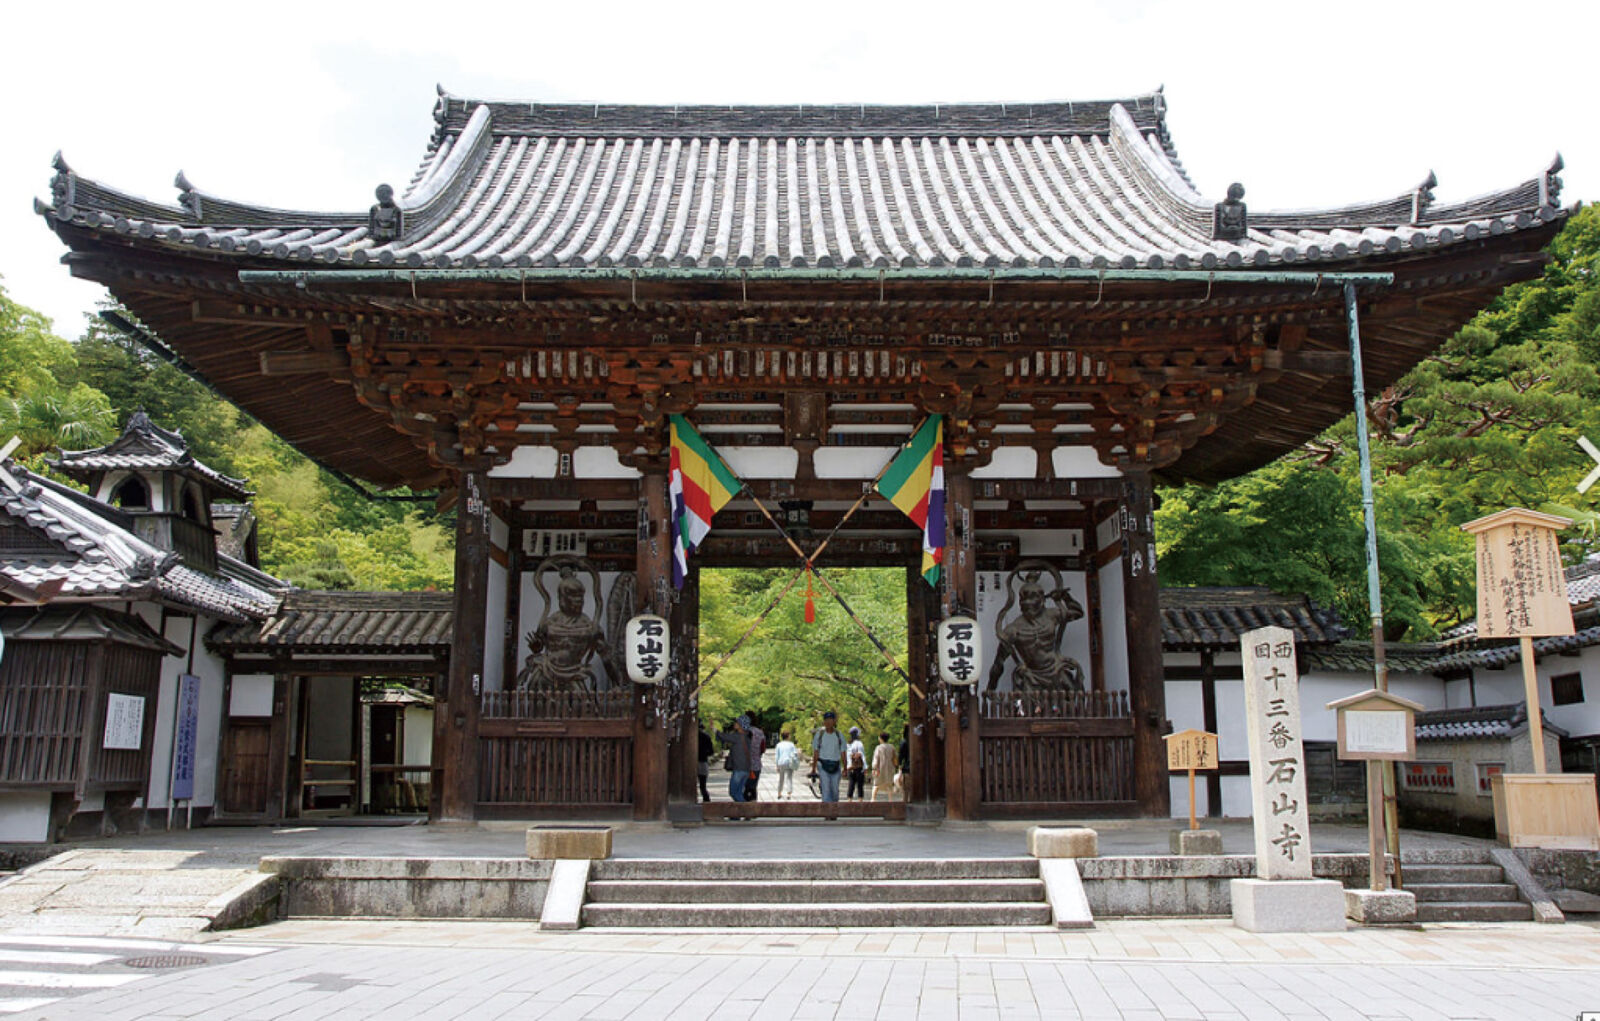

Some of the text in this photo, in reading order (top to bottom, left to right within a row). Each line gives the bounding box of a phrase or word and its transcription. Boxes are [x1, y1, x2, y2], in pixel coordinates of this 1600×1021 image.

[637, 619, 664, 678] 石山寺
[946, 623, 974, 682] 石山寺
